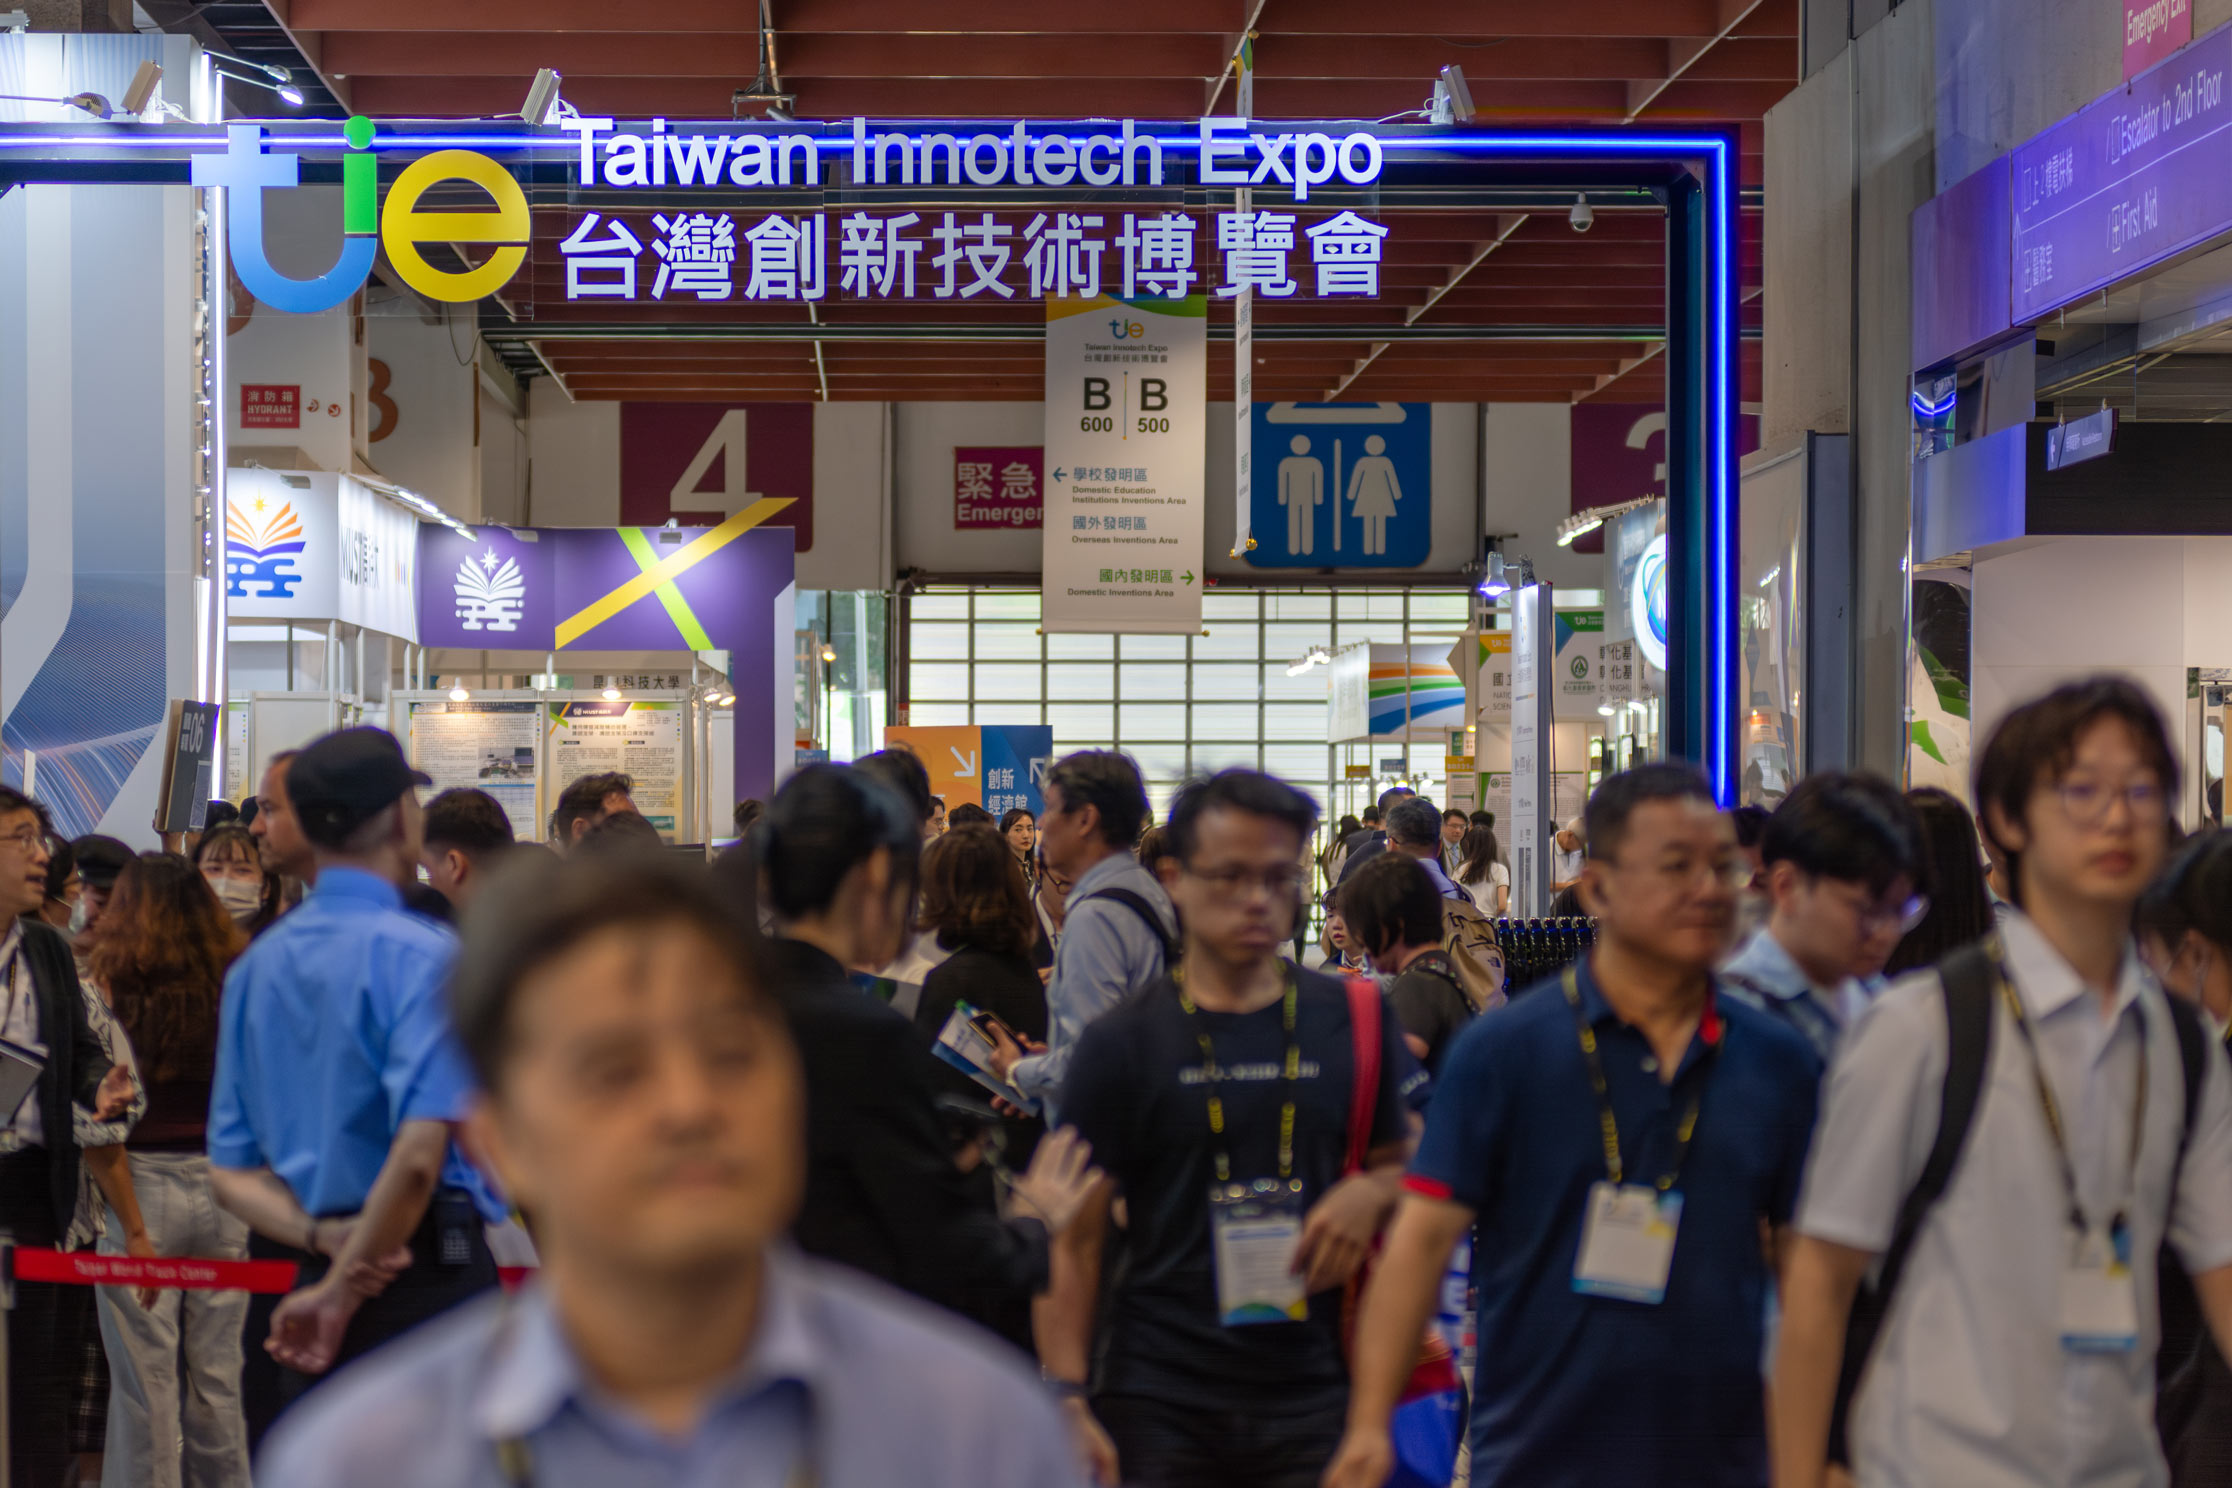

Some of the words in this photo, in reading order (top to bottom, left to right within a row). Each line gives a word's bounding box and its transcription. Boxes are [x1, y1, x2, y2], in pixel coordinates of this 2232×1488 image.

[2128, 0, 2169, 46] Emergency
[2122, 102, 2160, 156] Escalator
[2163, 93, 2171, 133] to
[2175, 76, 2193, 126] 2nd
[2198, 69, 2223, 114] Floor
[561, 118, 819, 186] Taiwan
[853, 117, 1162, 186] Innotech
[1200, 117, 1383, 200] Expo
[191, 115, 530, 314] tie
[2121, 200, 2141, 243] First
[2144, 185, 2158, 233] Aid
[560, 211, 1388, 300] 台灣創新技術博覽會
[1085, 343, 1111, 351] Taiwan
[1113, 343, 1146, 351] Innotech
[1148, 344, 1168, 353] Expo
[1084, 377, 1111, 410] B
[1141, 378, 1168, 411] B
[248, 404, 292, 414] HYDRANT
[1081, 417, 1113, 432] 600
[1138, 418, 1169, 433] 500
[670, 409, 763, 522] 4
[1073, 467, 1147, 482] 學校發明區
[957, 462, 1036, 500] 緊急
[1072, 486, 1112, 494] Domestic
[1114, 487, 1156, 495] Education
[1072, 496, 1119, 504] Institutions
[1121, 497, 1165, 505] Inventions
[1166, 497, 1187, 505] Area
[1072, 516, 1147, 530] 國外發明區
[1071, 535, 1111, 544] Overseas
[1113, 536, 1157, 544] Inventions
[1158, 536, 1179, 545] Area
[1099, 568, 1173, 584] 國內發明區
[1067, 588, 1107, 596] Domestic
[1109, 588, 1152, 597] Inventions
[1154, 589, 1174, 598] Area
[189, 711, 206, 754] 06
[988, 768, 1014, 790] 創新
